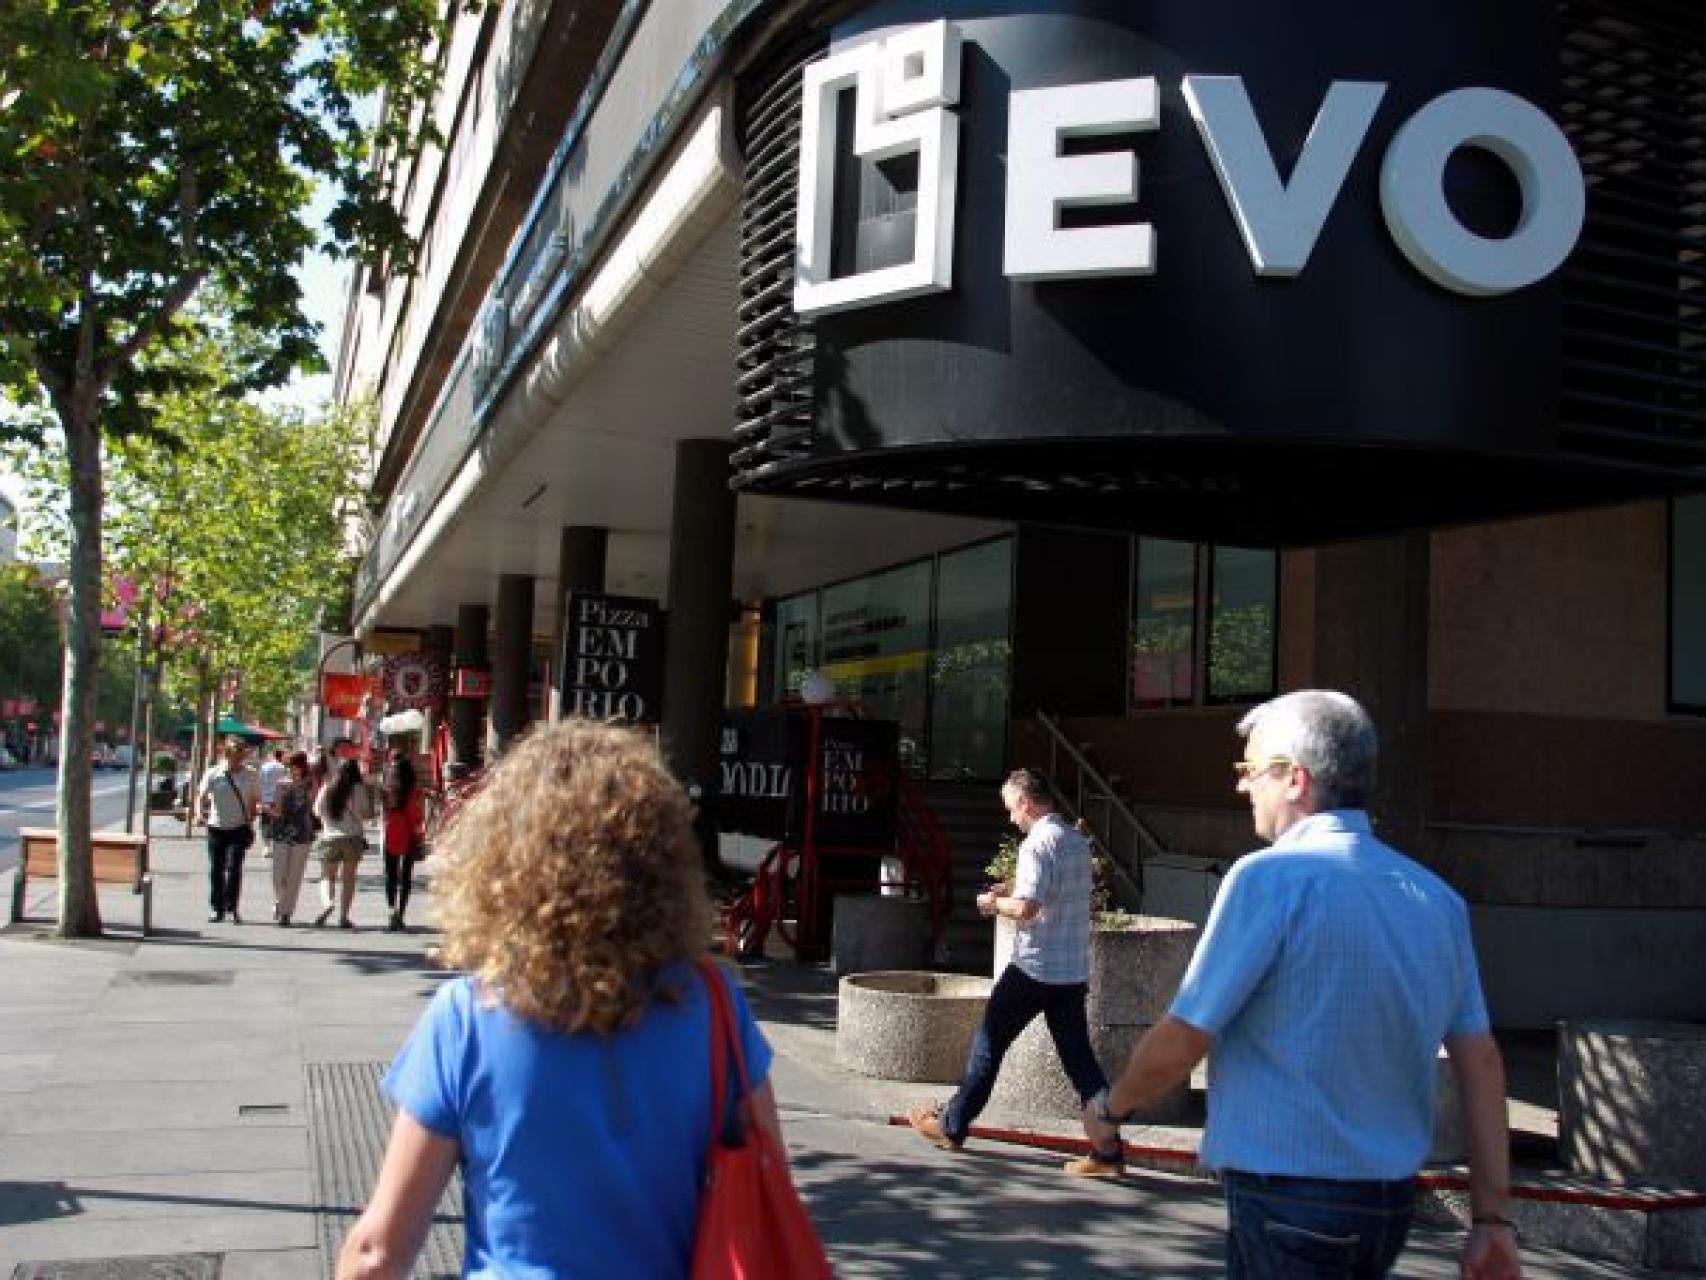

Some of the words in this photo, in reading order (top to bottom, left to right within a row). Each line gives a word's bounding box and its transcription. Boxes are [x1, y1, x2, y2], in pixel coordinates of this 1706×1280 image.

[1003, 75, 1586, 296] EVO
[580, 599, 648, 628] Pizza
[579, 627, 637, 659] EM
[577, 658, 627, 688] PO
